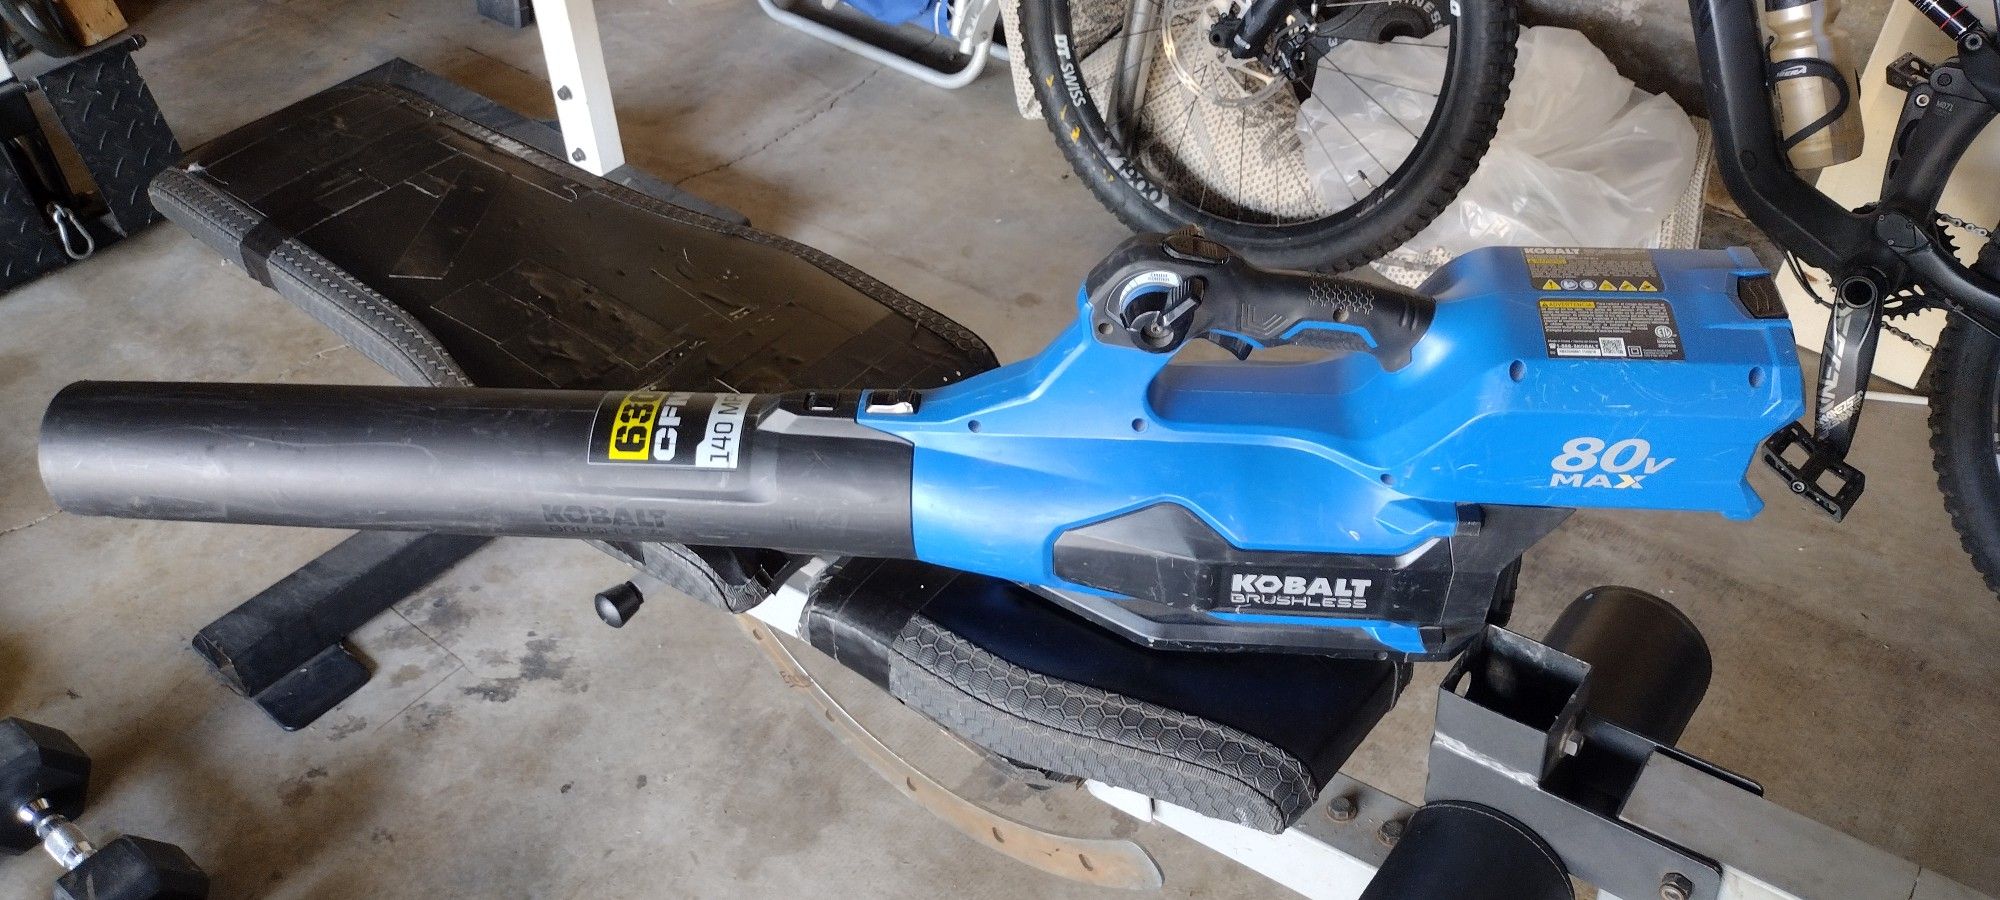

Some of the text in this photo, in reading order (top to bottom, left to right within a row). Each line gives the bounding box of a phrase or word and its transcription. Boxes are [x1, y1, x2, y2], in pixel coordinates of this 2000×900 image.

[1055, 34, 1086, 107] DT SWISS
[710, 421, 733, 462] 140
[1550, 474, 1647, 489] MAX
[541, 504, 666, 528] KOBALT
[1231, 574, 1371, 598] KOBALT
[1230, 593, 1367, 609] BRUSHLESS
